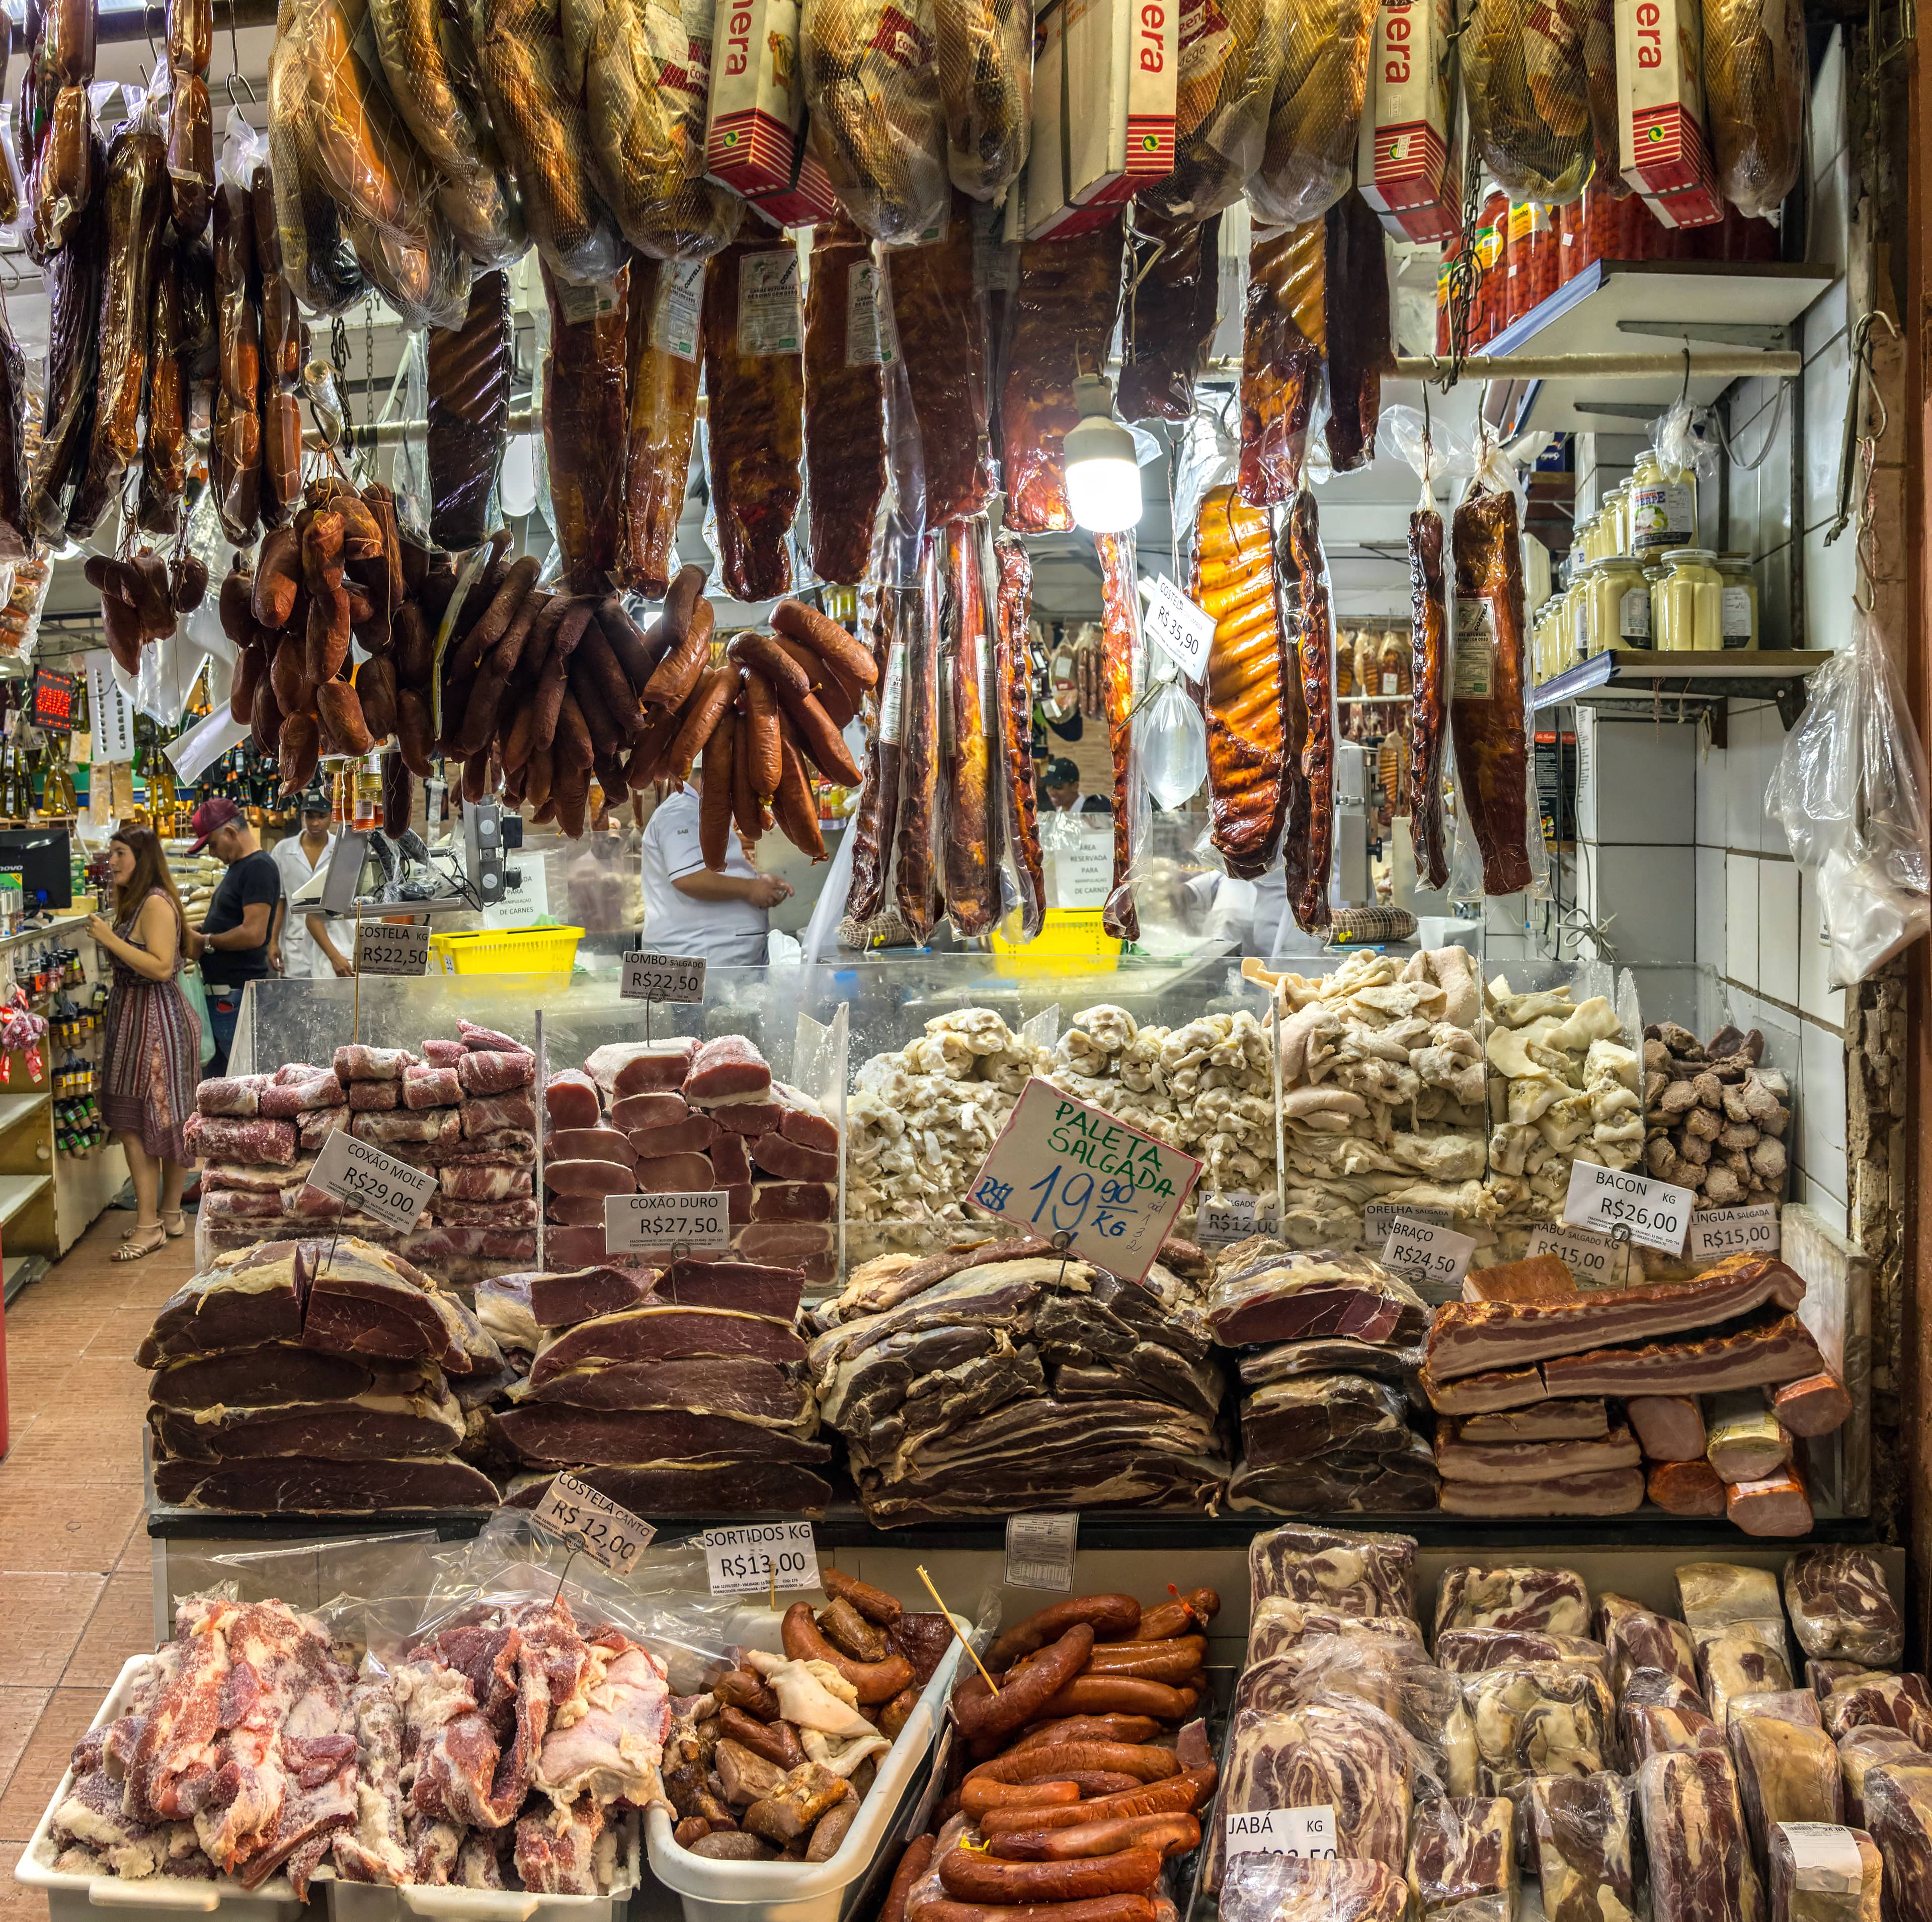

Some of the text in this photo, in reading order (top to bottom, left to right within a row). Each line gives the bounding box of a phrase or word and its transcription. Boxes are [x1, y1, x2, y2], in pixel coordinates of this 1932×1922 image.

[684, 265, 702, 289] COSTELA
[1160, 583, 1183, 610] COSTELA
[1474, 603, 1489, 631] COSTELA
[1170, 619, 1198, 655] 35,90
[359, 926, 428, 941] COSTELA KG
[363, 946, 428, 966] R$22,50
[625, 953, 703, 969] LOMBO SALGADO
[632, 971, 698, 992] R$22,50
[1055, 1100, 1163, 1173] PALETA
[348, 1144, 426, 1190] COXÃO MOLE
[1047, 1127, 1176, 1198] SALGADA
[343, 1167, 414, 1213] R$29,00
[1595, 1171, 1676, 1204] BACON KG
[630, 1195, 718, 1209] COXÃO DURO
[1366, 1205, 1413, 1214] ORELHA
[1600, 1197, 1677, 1233] R$26,00
[1737, 1209, 1770, 1220] SALGADA
[640, 1216, 717, 1236] R$27,50
[1090, 1211, 1127, 1237] KG
[1210, 1213, 1278, 1235] R$12,00
[1393, 1223, 1433, 1242] BRAÇO
[1534, 1223, 1620, 1250] RABO SALGADO KG
[1703, 1226, 1770, 1248] R$15,00
[1393, 1245, 1456, 1272] R$24,50
[1537, 1240, 1604, 1269] R$15,00
[559, 1473, 650, 1537] COSTELA CANTO
[551, 1499, 636, 1560] R$ 12,00
[705, 1524, 811, 1547] SORTIDOS KG
[721, 1552, 806, 1579] R$13,00
[1228, 1811, 1323, 1834] JABÁ KG
